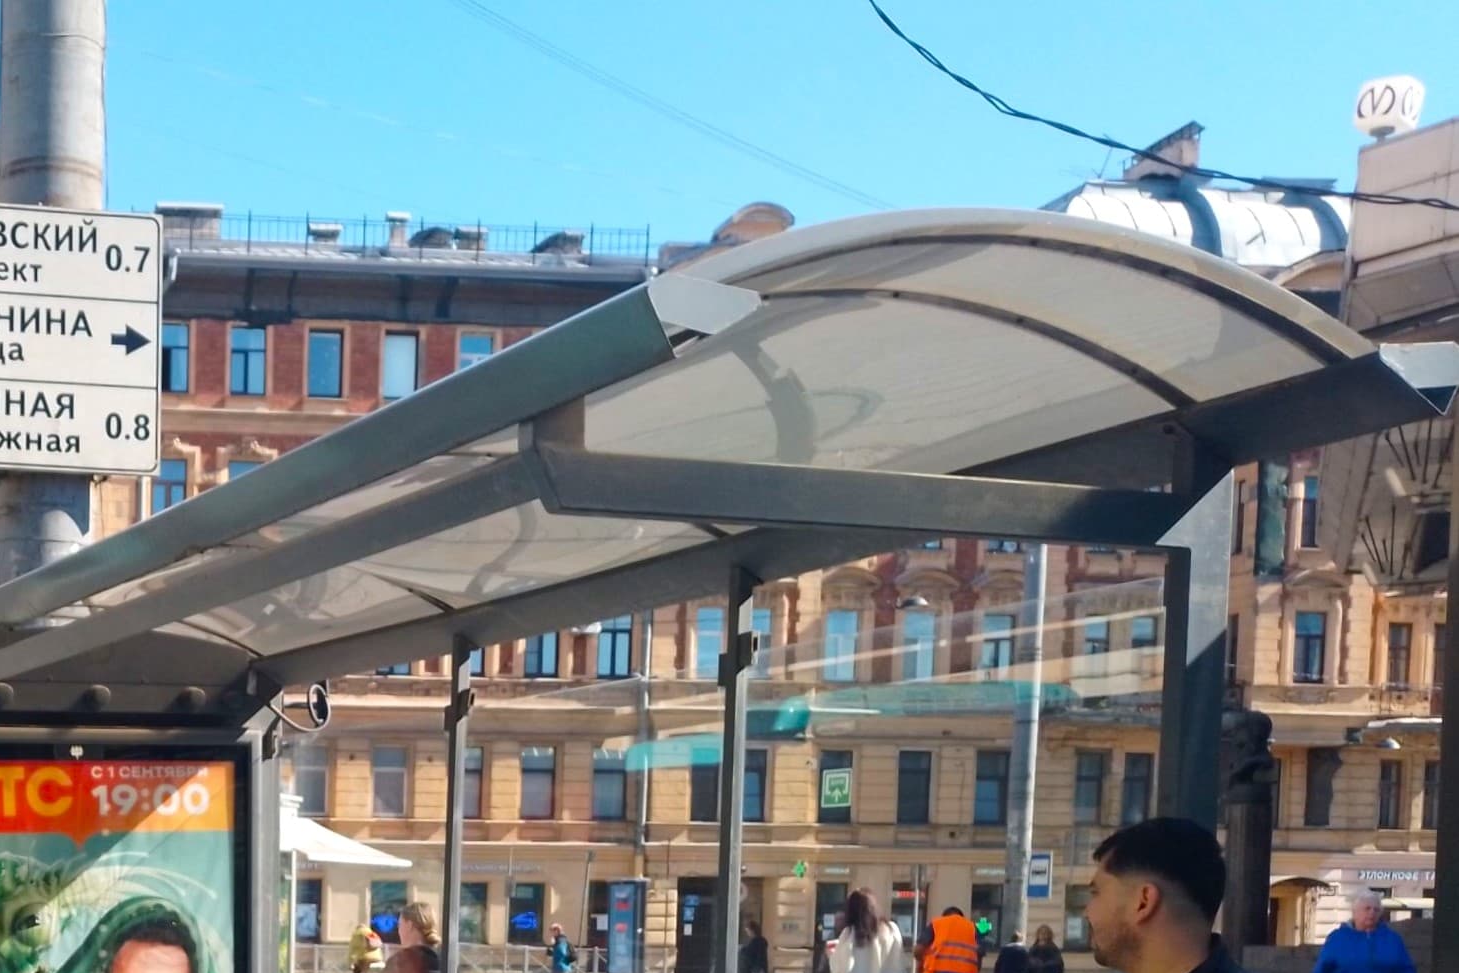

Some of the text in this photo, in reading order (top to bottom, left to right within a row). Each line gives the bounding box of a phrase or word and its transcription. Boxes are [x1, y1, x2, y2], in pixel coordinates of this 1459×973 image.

[105, 244, 151, 273] 0.7
[105, 413, 151, 441] 0.8
[91, 765, 208, 778] С 1 СЕНТЯБРЯ
[91, 783, 210, 816] 19:00
[1392, 871, 1419, 881] КОФЕ
